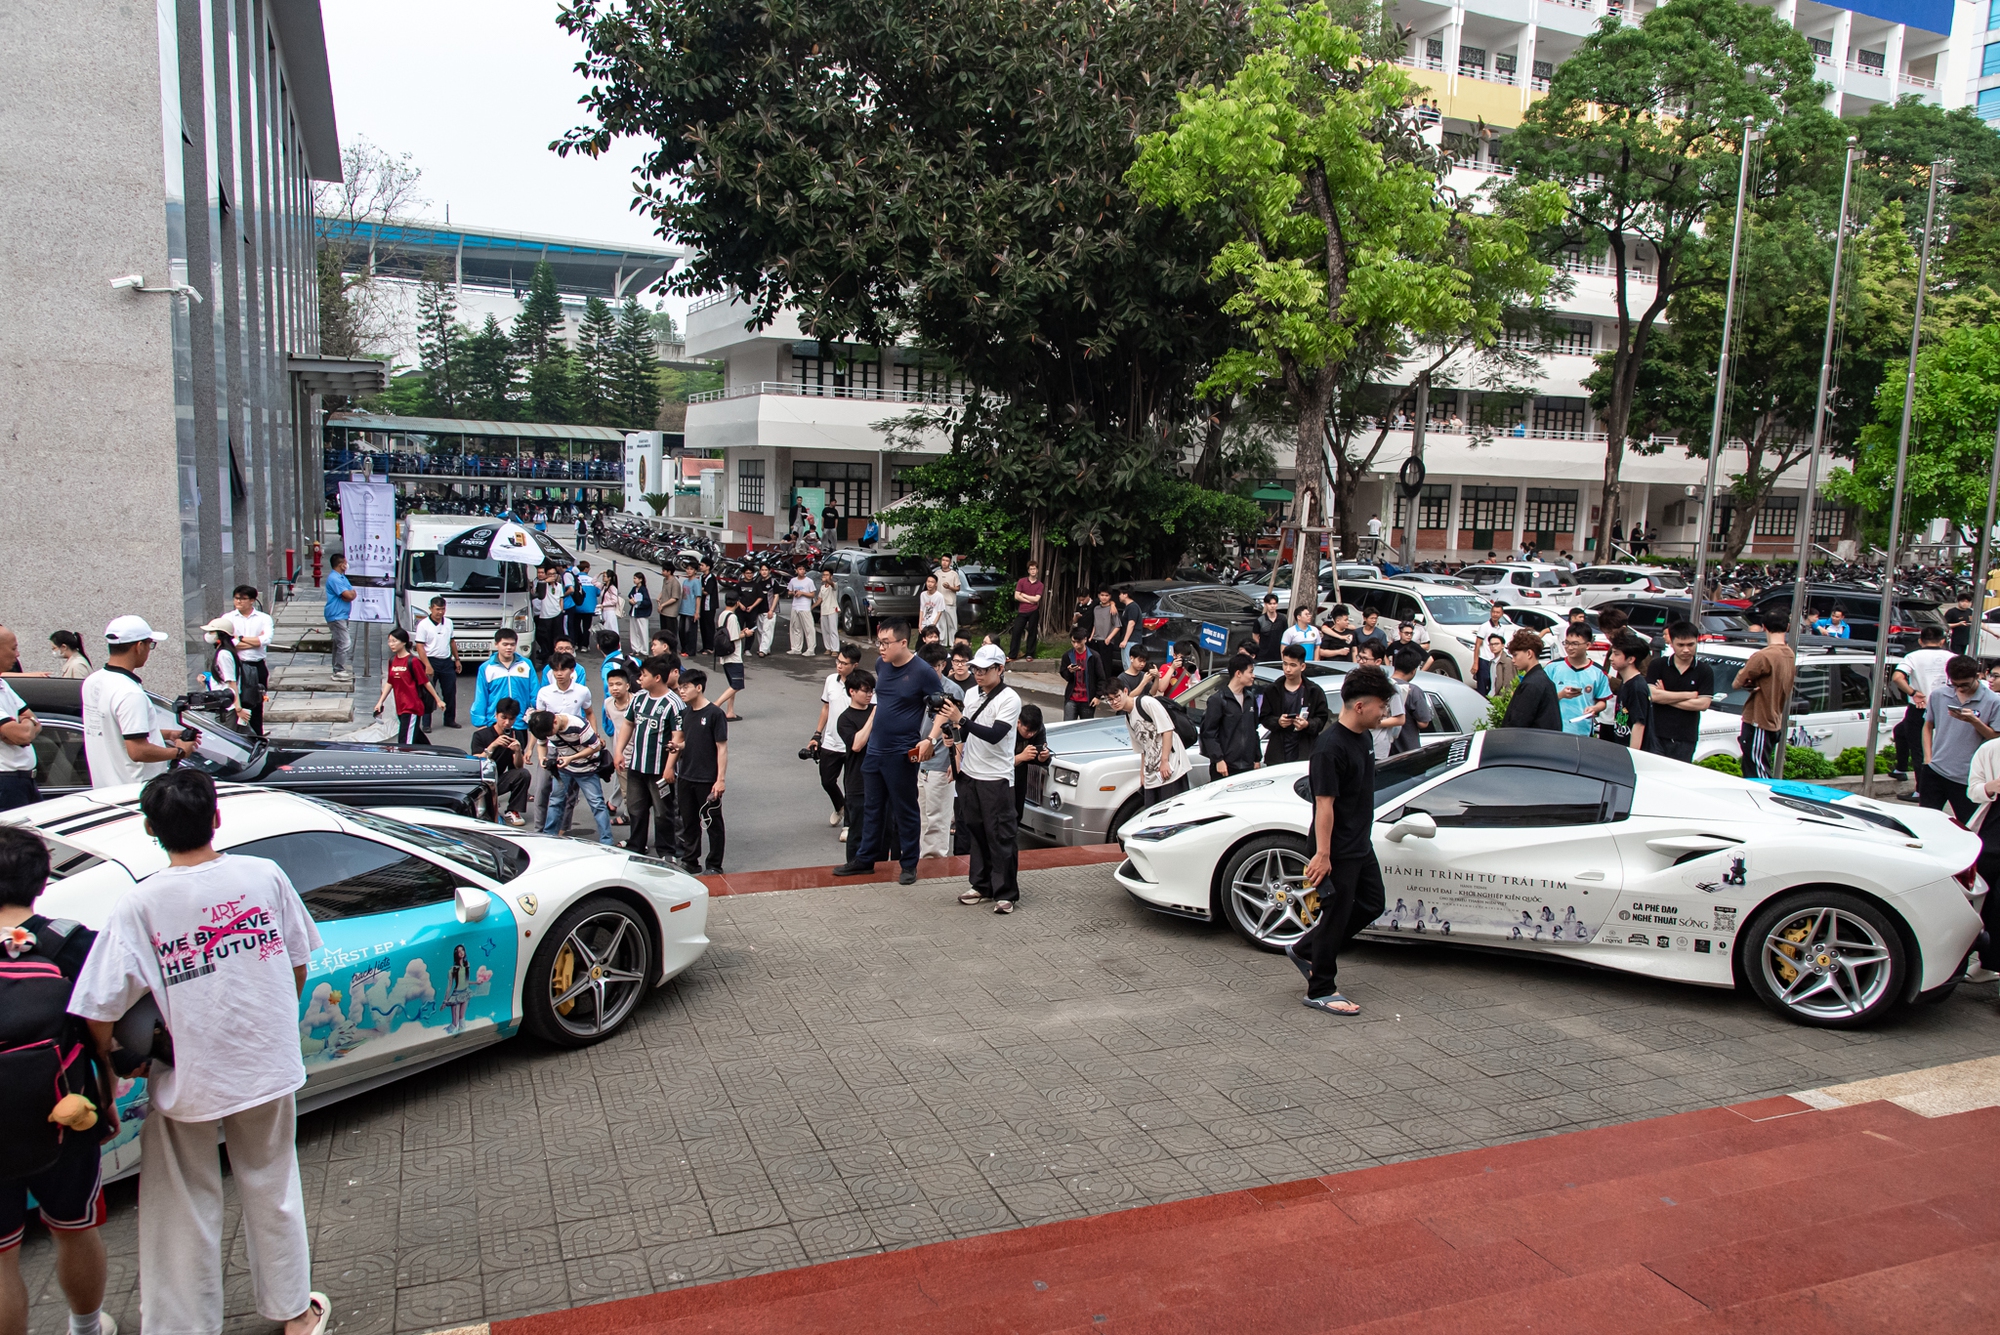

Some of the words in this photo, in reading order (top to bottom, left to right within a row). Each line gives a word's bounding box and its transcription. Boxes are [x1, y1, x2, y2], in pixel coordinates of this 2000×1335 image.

[1706, 656, 1722, 664] No.1
[1384, 865, 1423, 877] HÀNH
[1430, 868, 1474, 882] TRÌNH
[1479, 873, 1496, 883] TỪ
[1502, 876, 1534, 887] TRÁI
[1541, 879, 1567, 890] TIM
[1632, 901, 1643, 911] CÀ
[1644, 903, 1660, 912] PHÊ
[158, 936, 190, 957] WE
[162, 956, 196, 976] HE
[203, 929, 279, 965] FUTURE
[323, 948, 369, 968] FIRST
[373, 941, 394, 955] EP
